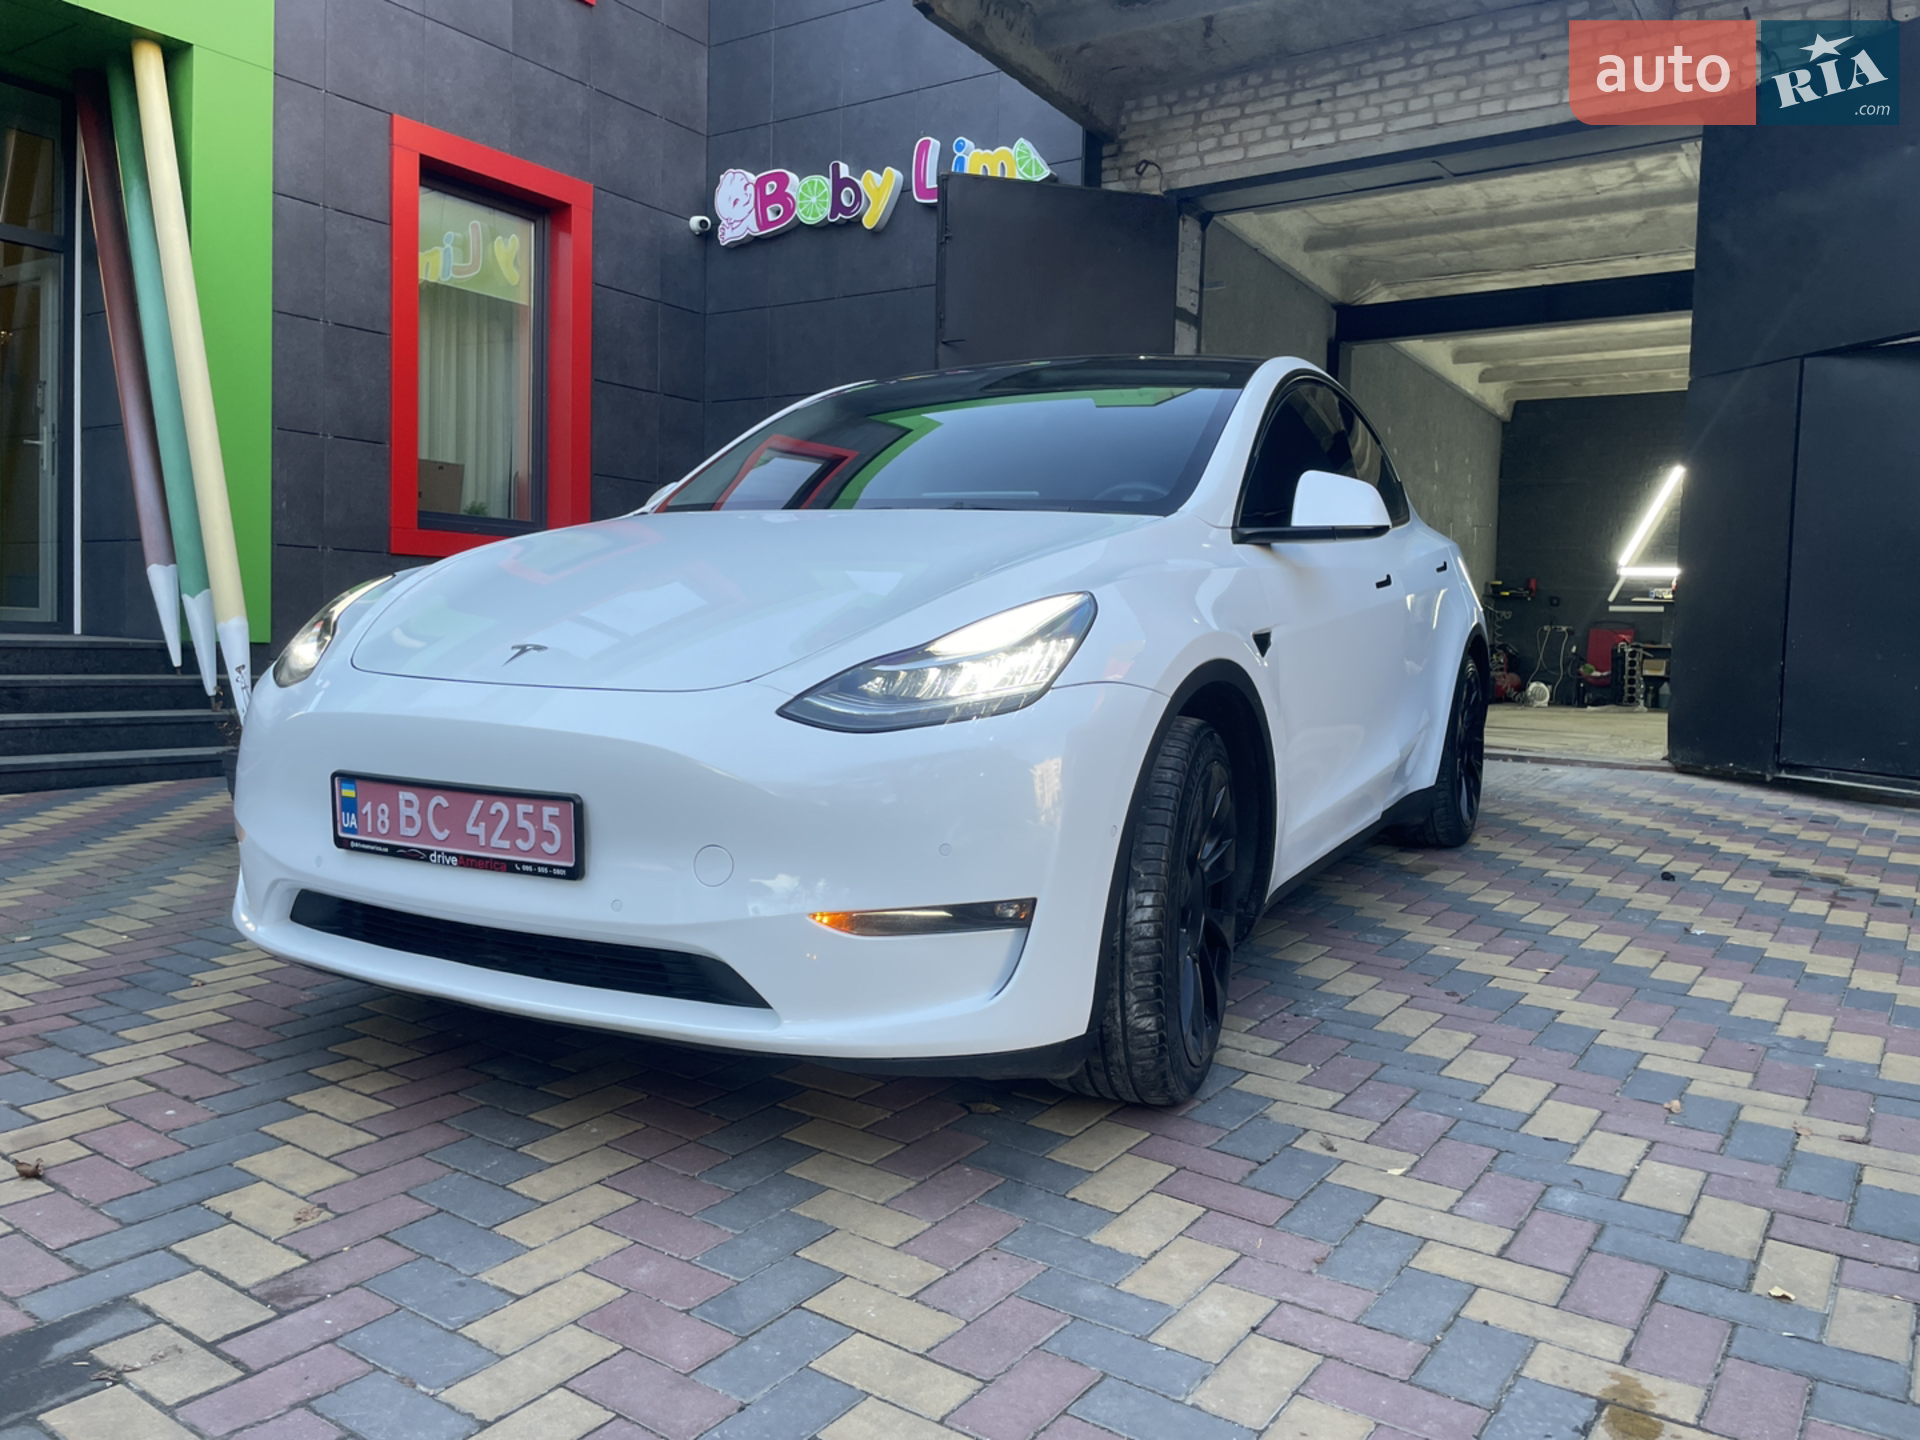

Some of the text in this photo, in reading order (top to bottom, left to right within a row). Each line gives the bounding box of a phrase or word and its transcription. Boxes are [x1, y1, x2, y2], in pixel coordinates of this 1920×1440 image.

[341, 811, 358, 829] UA
[361, 791, 562, 855] 18 BC 4255
[429, 850, 508, 873] driveAmerica
